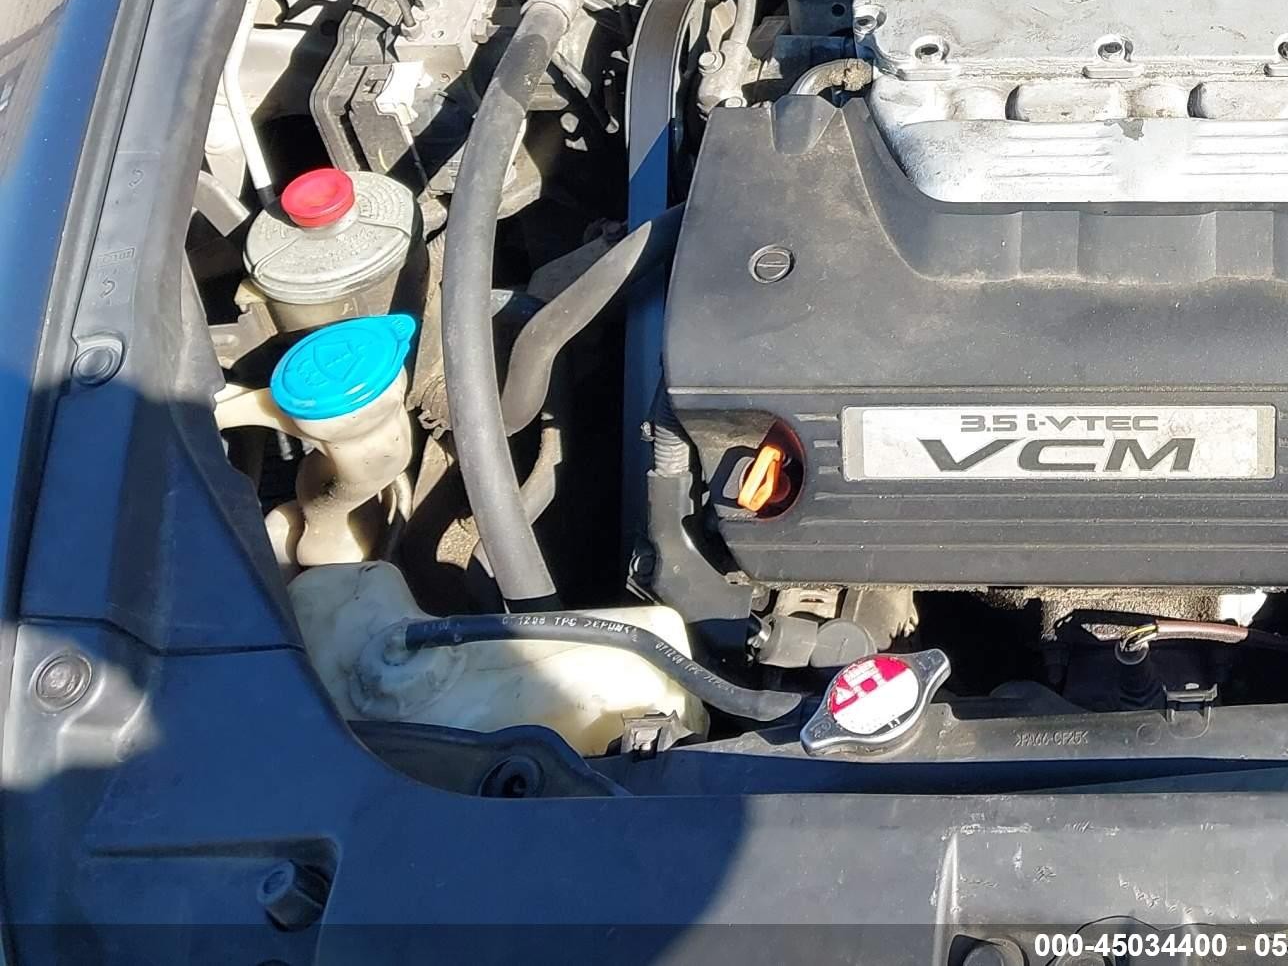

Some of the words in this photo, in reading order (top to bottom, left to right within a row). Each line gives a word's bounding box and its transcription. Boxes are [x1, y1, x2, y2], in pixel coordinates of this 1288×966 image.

[960, 414, 1018, 433] 3.5
[1026, 413, 1159, 432] i-VTEC
[916, 436, 1197, 473] VCM
